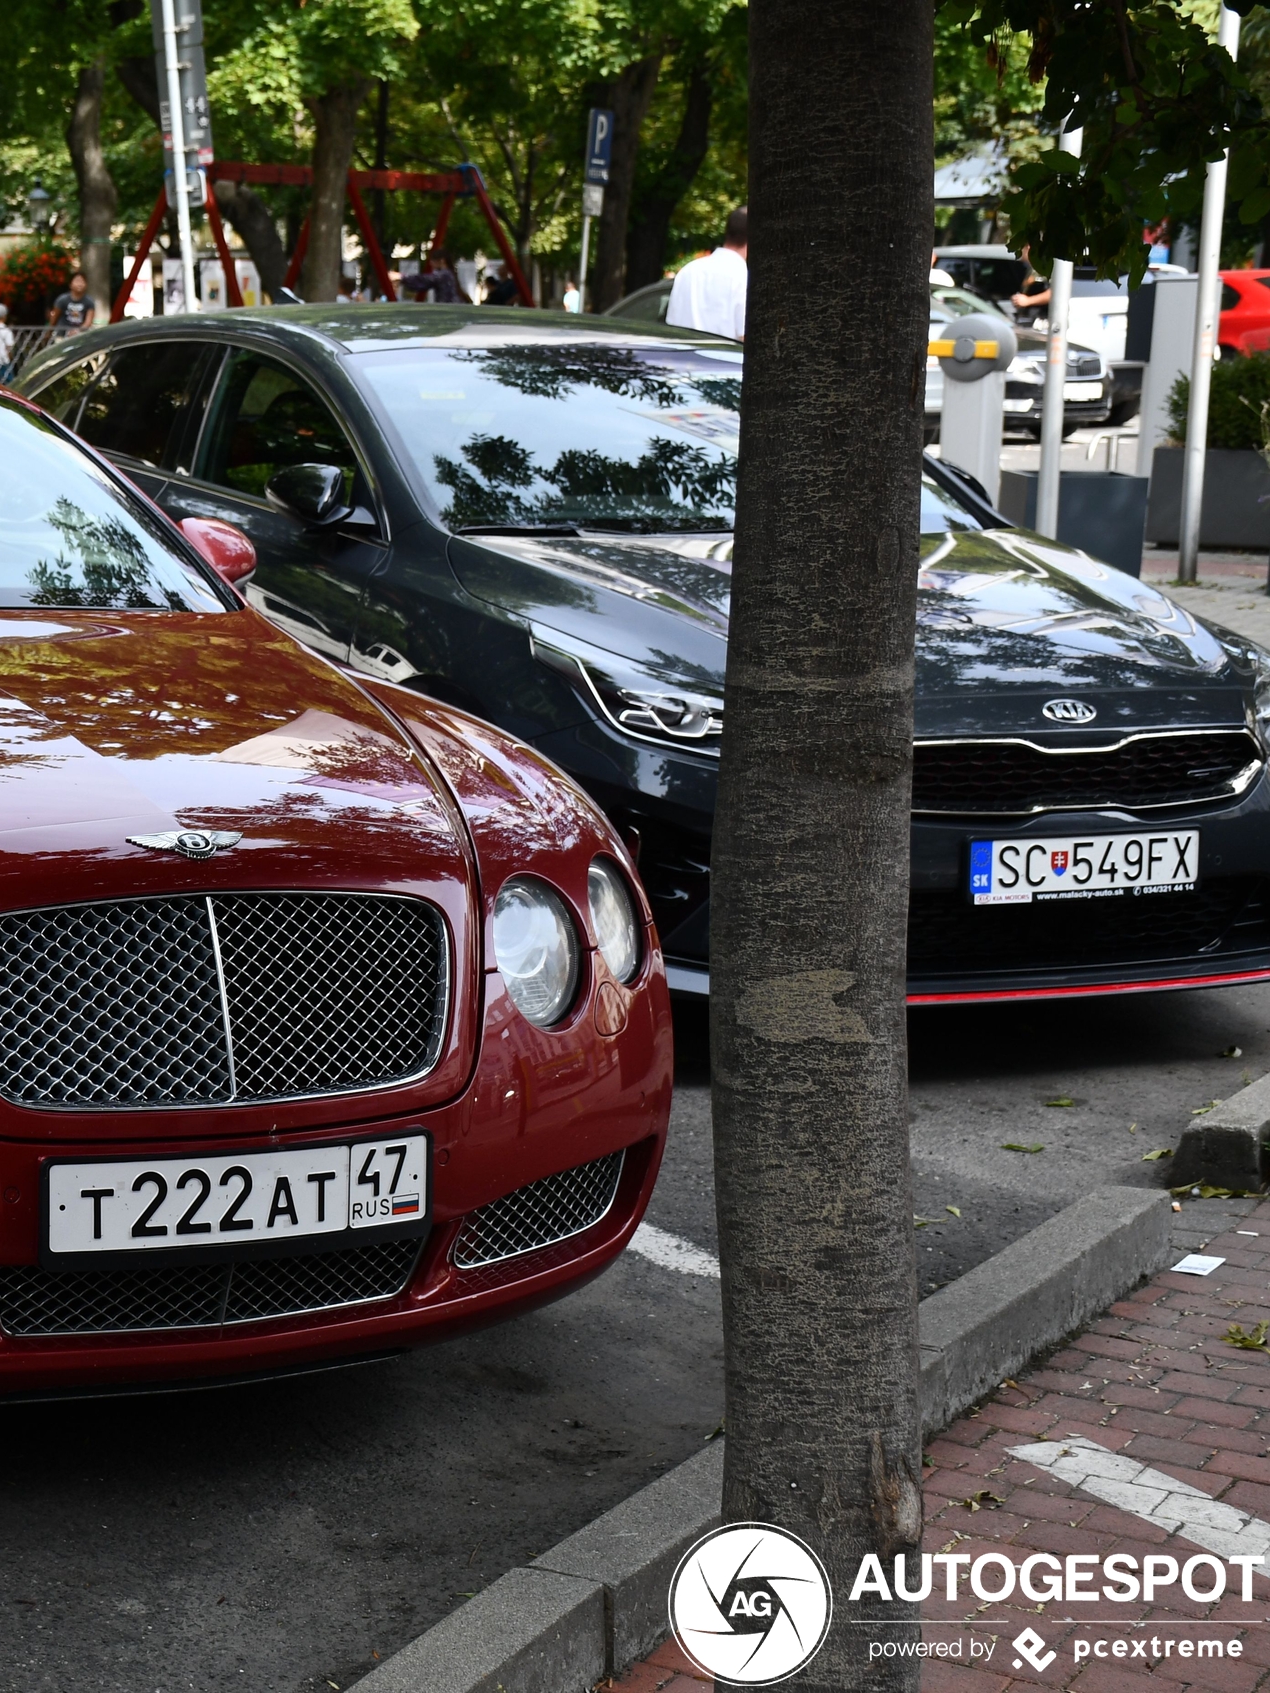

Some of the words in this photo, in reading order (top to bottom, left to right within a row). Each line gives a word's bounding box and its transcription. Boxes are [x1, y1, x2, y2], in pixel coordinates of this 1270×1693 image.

[595, 114, 608, 154] P
[1049, 703, 1092, 718] KIA
[998, 844, 1047, 888] SC
[1072, 836, 1193, 884] 549FX
[973, 874, 988, 887] SK
[1143, 885, 1171, 894] 034/321
[1185, 883, 1194, 891] 14
[1036, 888, 1124, 900] www.malacky-auto.sk
[357, 1144, 408, 1196] 47
[352, 1198, 390, 1219] RUS
